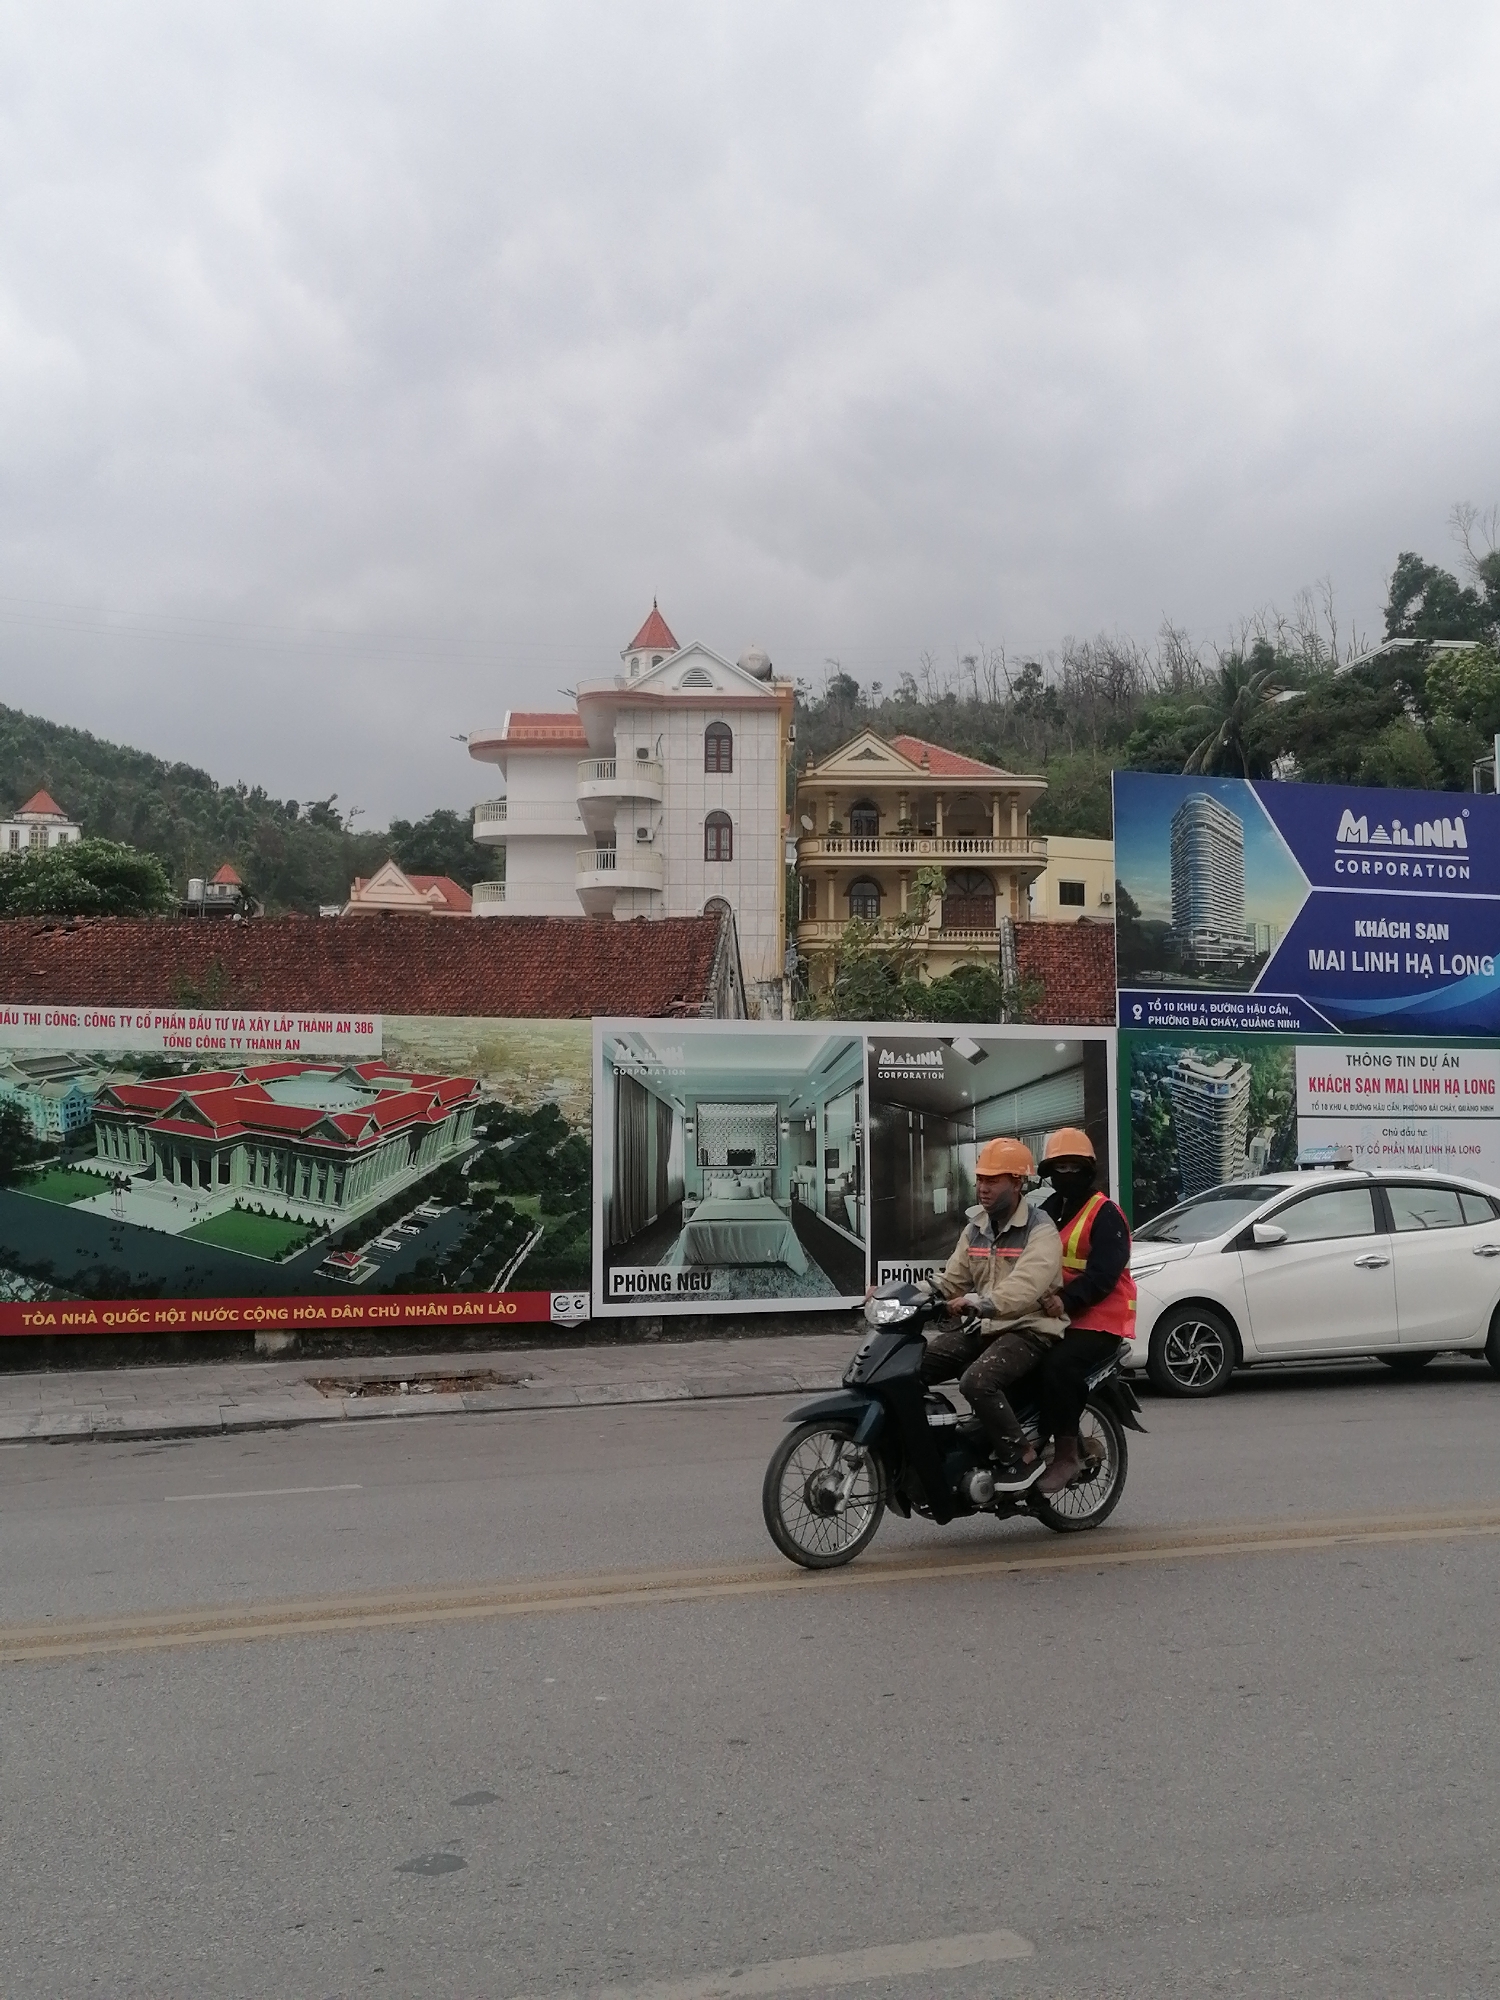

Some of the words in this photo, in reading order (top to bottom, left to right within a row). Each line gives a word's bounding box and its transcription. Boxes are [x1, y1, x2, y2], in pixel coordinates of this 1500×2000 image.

[1334, 859, 1470, 879] CORPORATION
[1354, 918, 1411, 939] KHÁCH
[1415, 923, 1449, 943] SẠN
[1308, 949, 1346, 971] MAI
[1351, 951, 1399, 973] LINH
[1405, 952, 1434, 979] HẠ
[1439, 954, 1495, 976] LONG
[1148, 998, 1162, 1011] TỔ
[1163, 1002, 1175, 1012] 10
[1177, 1003, 1198, 1013] KHU
[1199, 1003, 1208, 1014] 4,
[1246, 1002, 1268, 1016] HẬU
[23, 1012, 41, 1025] THI
[45, 1010, 81, 1027] CÔNG:
[84, 1011, 116, 1028] CÔNG
[119, 1015, 132, 1028] TY
[136, 1011, 152, 1029] CỔ
[215, 1017, 229, 1031] TƯ
[232, 1016, 246, 1031] VÀ
[250, 1016, 271, 1032] XÂY
[298, 1017, 333, 1033] THÀNH
[336, 1020, 351, 1033] AN
[354, 1021, 374, 1034] 386
[1148, 1014, 1190, 1026] PHƯỜNG
[1210, 1016, 1239, 1029] CHÁY,
[1241, 1016, 1275, 1028] QUẢNG
[1277, 1019, 1300, 1029] NINH
[163, 1032, 192, 1048] TỔNG
[195, 1035, 226, 1049] CÔNG
[230, 1037, 242, 1049] TY
[246, 1036, 282, 1050] THÀNH
[285, 1039, 300, 1050] AN
[1345, 1052, 1392, 1067] THÔNG
[1396, 1055, 1416, 1067] TIN
[1420, 1055, 1438, 1071] DỰ
[1441, 1053, 1460, 1068] ÁN
[613, 1067, 686, 1076] CORPORATION
[877, 1071, 945, 1080] CORPORATION
[1308, 1073, 1351, 1093] KHÁCH
[1355, 1077, 1381, 1097] SẠN
[1385, 1078, 1409, 1094] MAI
[1412, 1078, 1440, 1094] LINH
[1444, 1079, 1460, 1098] HẠ
[1464, 1079, 1496, 1095] LONG
[1329, 1103, 1342, 1111] KHU
[1355, 1145, 1364, 1154] TY
[1367, 1140, 1380, 1154] CỔ
[1407, 1145, 1423, 1154] MAI
[1425, 1145, 1442, 1154] LINH
[1445, 1145, 1457, 1157] HẠ
[1458, 1145, 1481, 1155] LONG
[613, 1269, 671, 1293] PHÒNG
[677, 1266, 713, 1291] NGỦ
[881, 1264, 934, 1285] PHÒNG
[22, 1310, 57, 1325] TÒA
[61, 1309, 98, 1325] NHÀ
[102, 1308, 150, 1326] QUỐC
[155, 1307, 186, 1325] HỘI
[191, 1306, 239, 1322] NƯỚC
[243, 1306, 288, 1323] CỘNG
[293, 1304, 327, 1319] HÒA
[331, 1305, 363, 1318] DÂN
[368, 1302, 400, 1318] CHỦ
[405, 1304, 447, 1316] NHÂN
[452, 1301, 483, 1315] DÂN
[489, 1300, 517, 1315] LÀO
